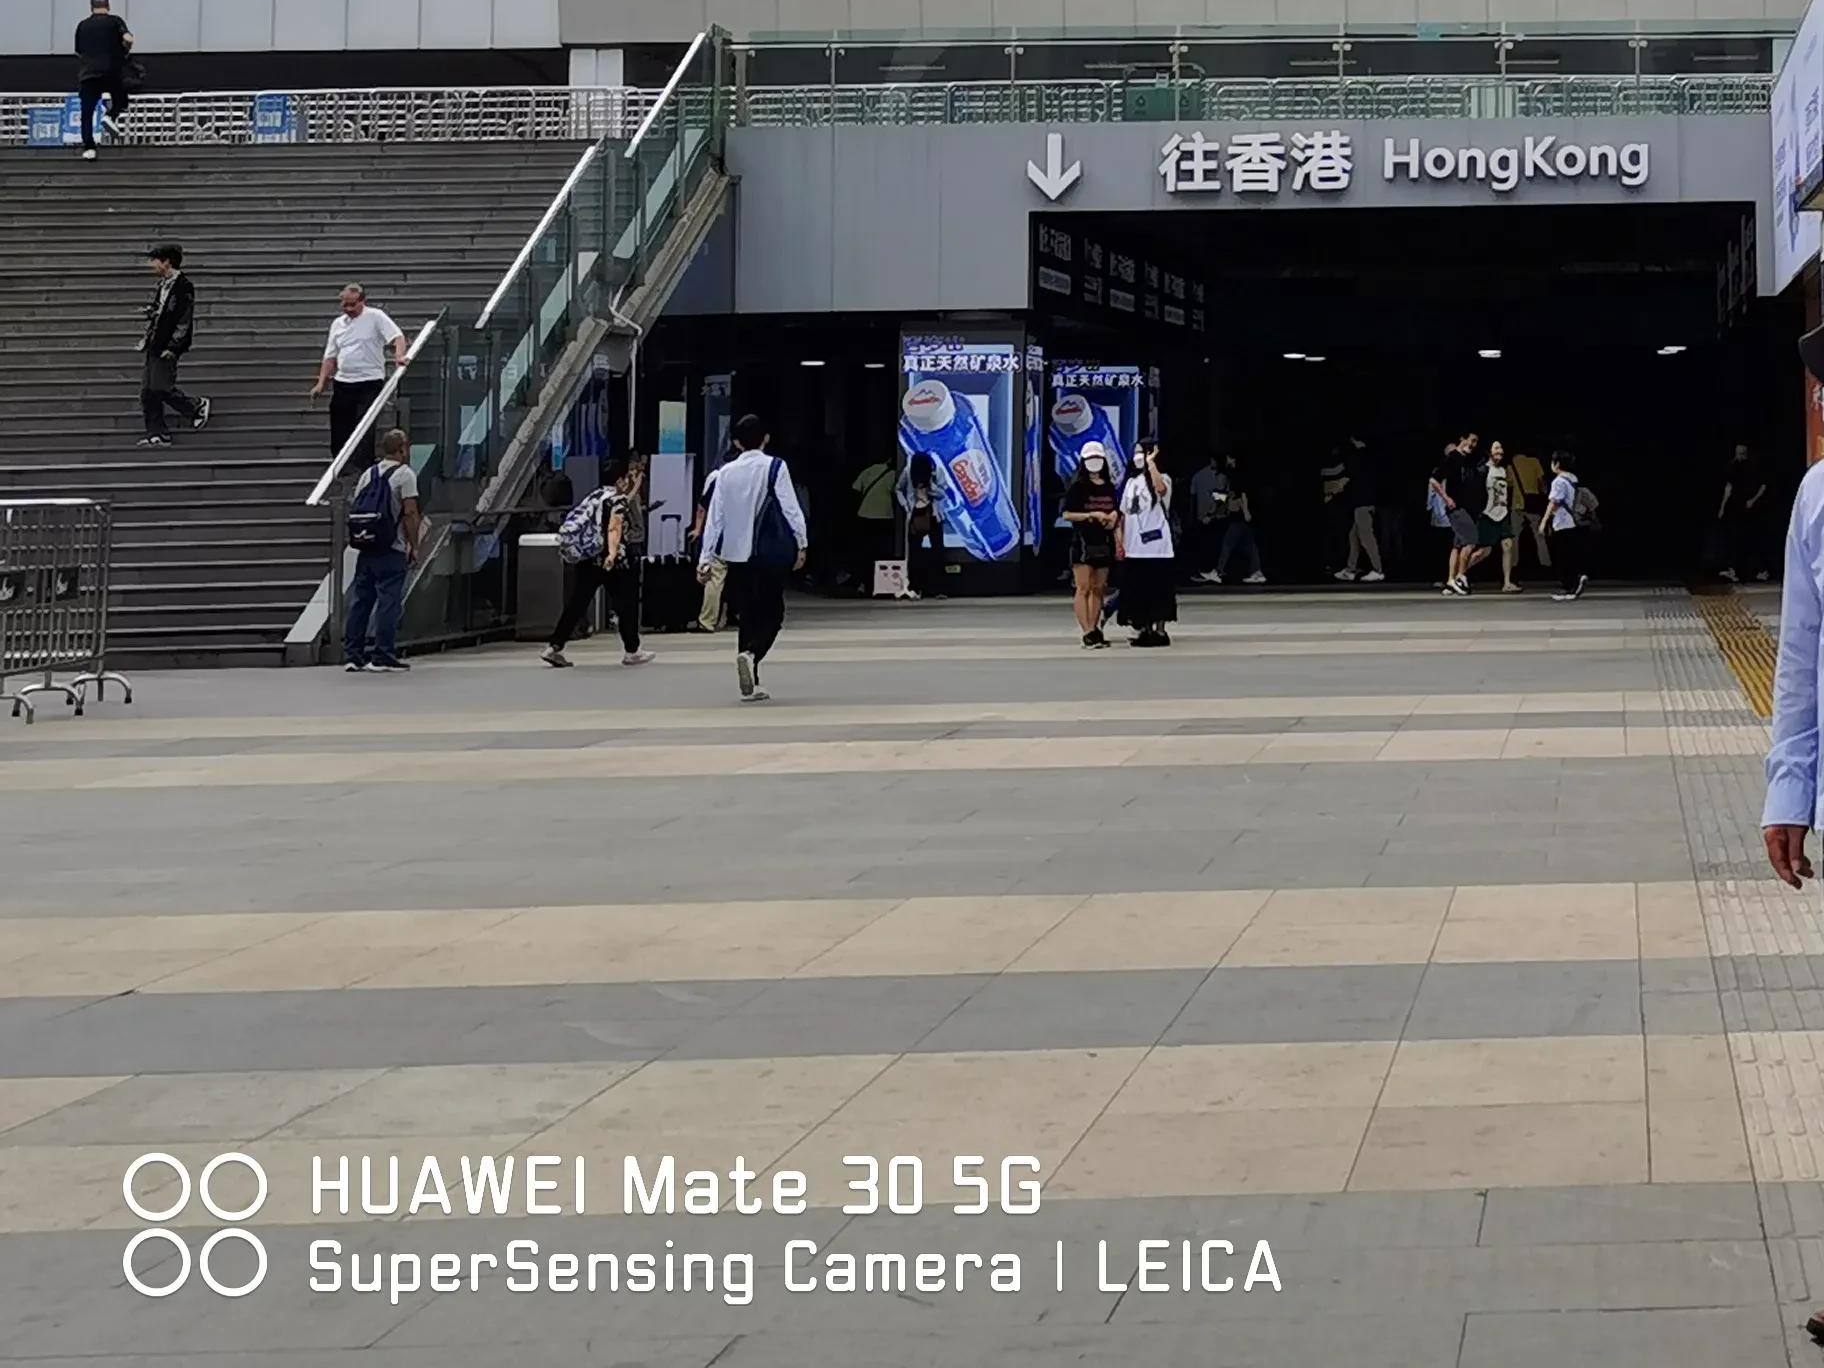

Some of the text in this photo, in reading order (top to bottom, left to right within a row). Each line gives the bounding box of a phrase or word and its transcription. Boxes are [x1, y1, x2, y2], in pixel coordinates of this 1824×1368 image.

[1158, 130, 1353, 193] 往香港
[1383, 135, 1650, 191] HongKong
[903, 352, 1021, 373] 真正天然矿泉水
[1051, 372, 1146, 389] 真正天然矿泉水
